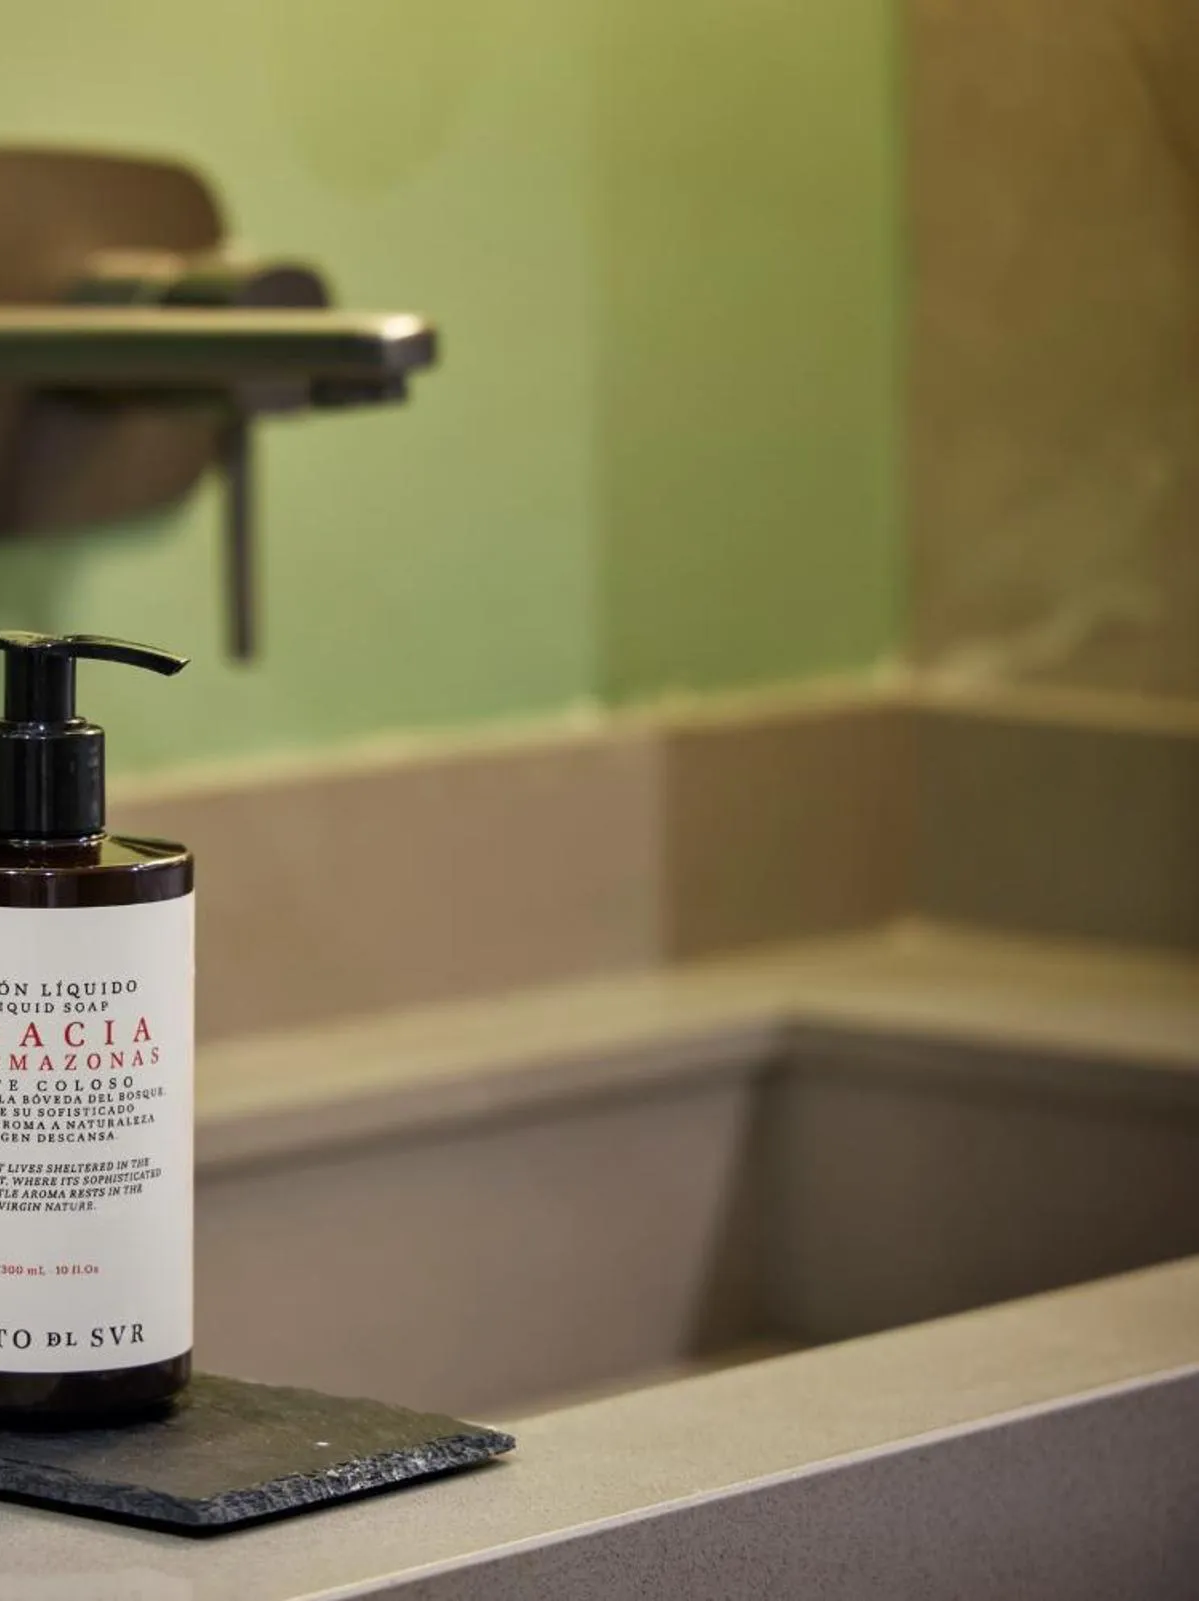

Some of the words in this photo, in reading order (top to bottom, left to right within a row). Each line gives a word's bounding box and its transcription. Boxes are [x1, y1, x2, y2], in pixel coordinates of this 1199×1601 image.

[40, 979, 138, 999] LÍQUIDO
[63, 1000, 109, 1014] SOAP
[37, 1075, 133, 1092] COLOSO
[22, 1093, 83, 1105] BÓVEDA
[88, 1093, 114, 1104] DEL
[13, 1107, 32, 1117] SU
[37, 1103, 135, 1117] SOFISTICADO
[51, 1120, 60, 1130] A
[66, 1114, 155, 1130] NATURALEZA
[7, 1163, 43, 1174] LIVES
[46, 1160, 114, 1174] SHELTERED
[117, 1159, 129, 1171] IN
[131, 1157, 151, 1168] THE
[11, 1176, 57, 1187] WHERE
[60, 1176, 80, 1186] ITS
[82, 1168, 162, 1186] SOPHISTICATED
[21, 1189, 66, 1199] AROMA
[69, 1187, 106, 1199] RESTS
[108, 1186, 121, 1197] IN
[123, 1183, 143, 1194] THE
[0, 1264, 24, 1275] 300
[55, 1264, 69, 1275] 10
[90, 1323, 145, 1348] SVR
